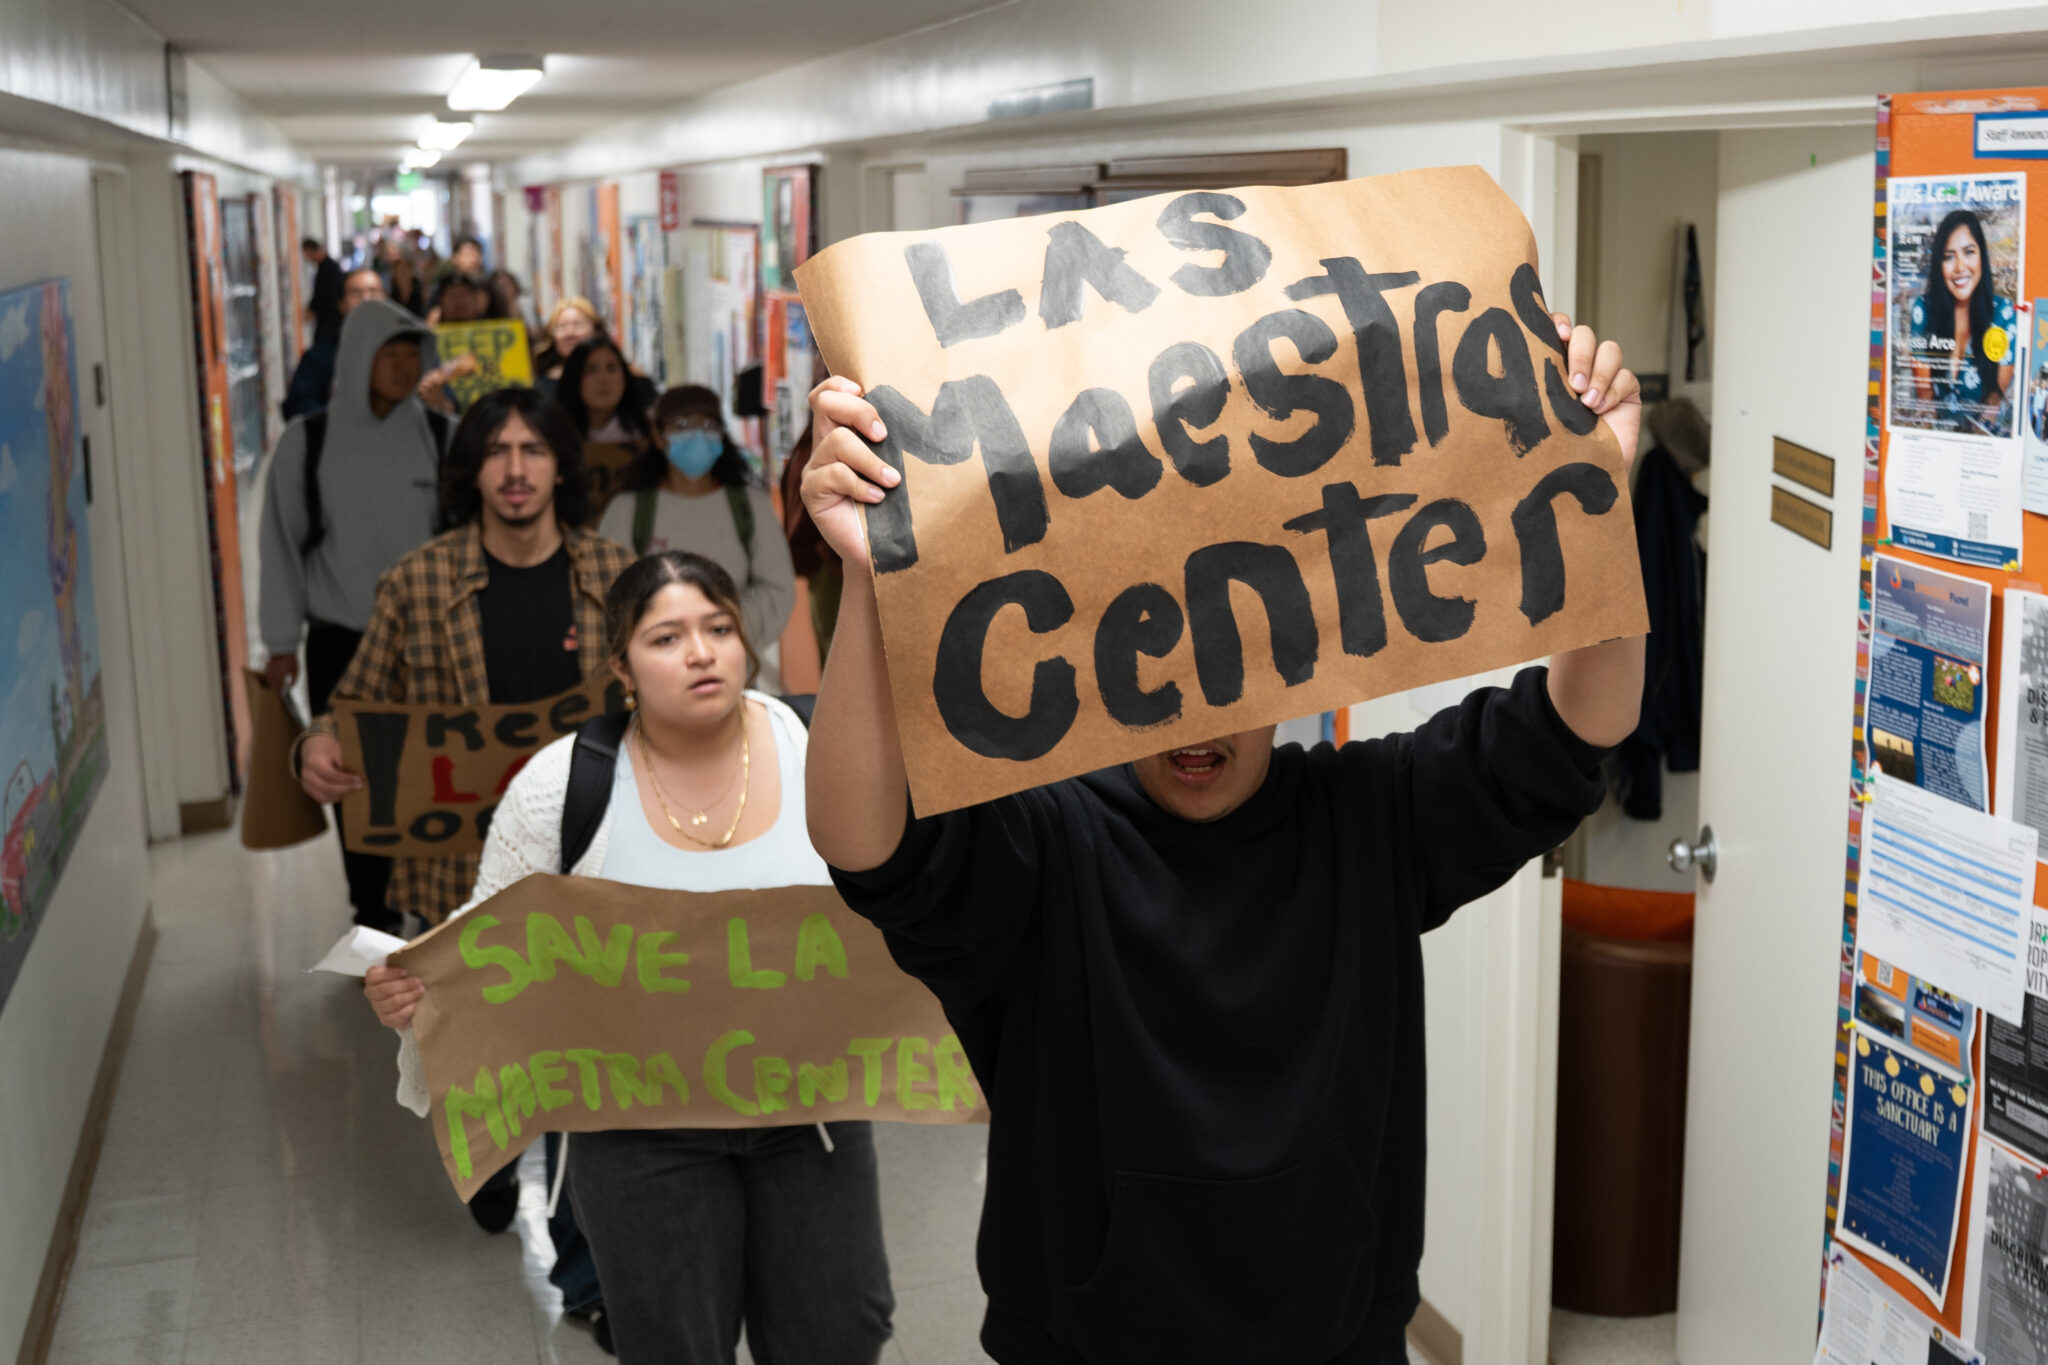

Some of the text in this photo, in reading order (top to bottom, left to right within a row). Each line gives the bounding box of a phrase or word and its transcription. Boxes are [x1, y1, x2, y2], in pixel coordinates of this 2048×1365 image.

[903, 191, 1273, 348] LAS
[932, 462, 1619, 762] Center
[458, 911, 849, 1004] SAVE LA
[1862, 1063, 1957, 1133] THIS OFFICE IS A
[1876, 1095, 1940, 1147] SANCTUARY
